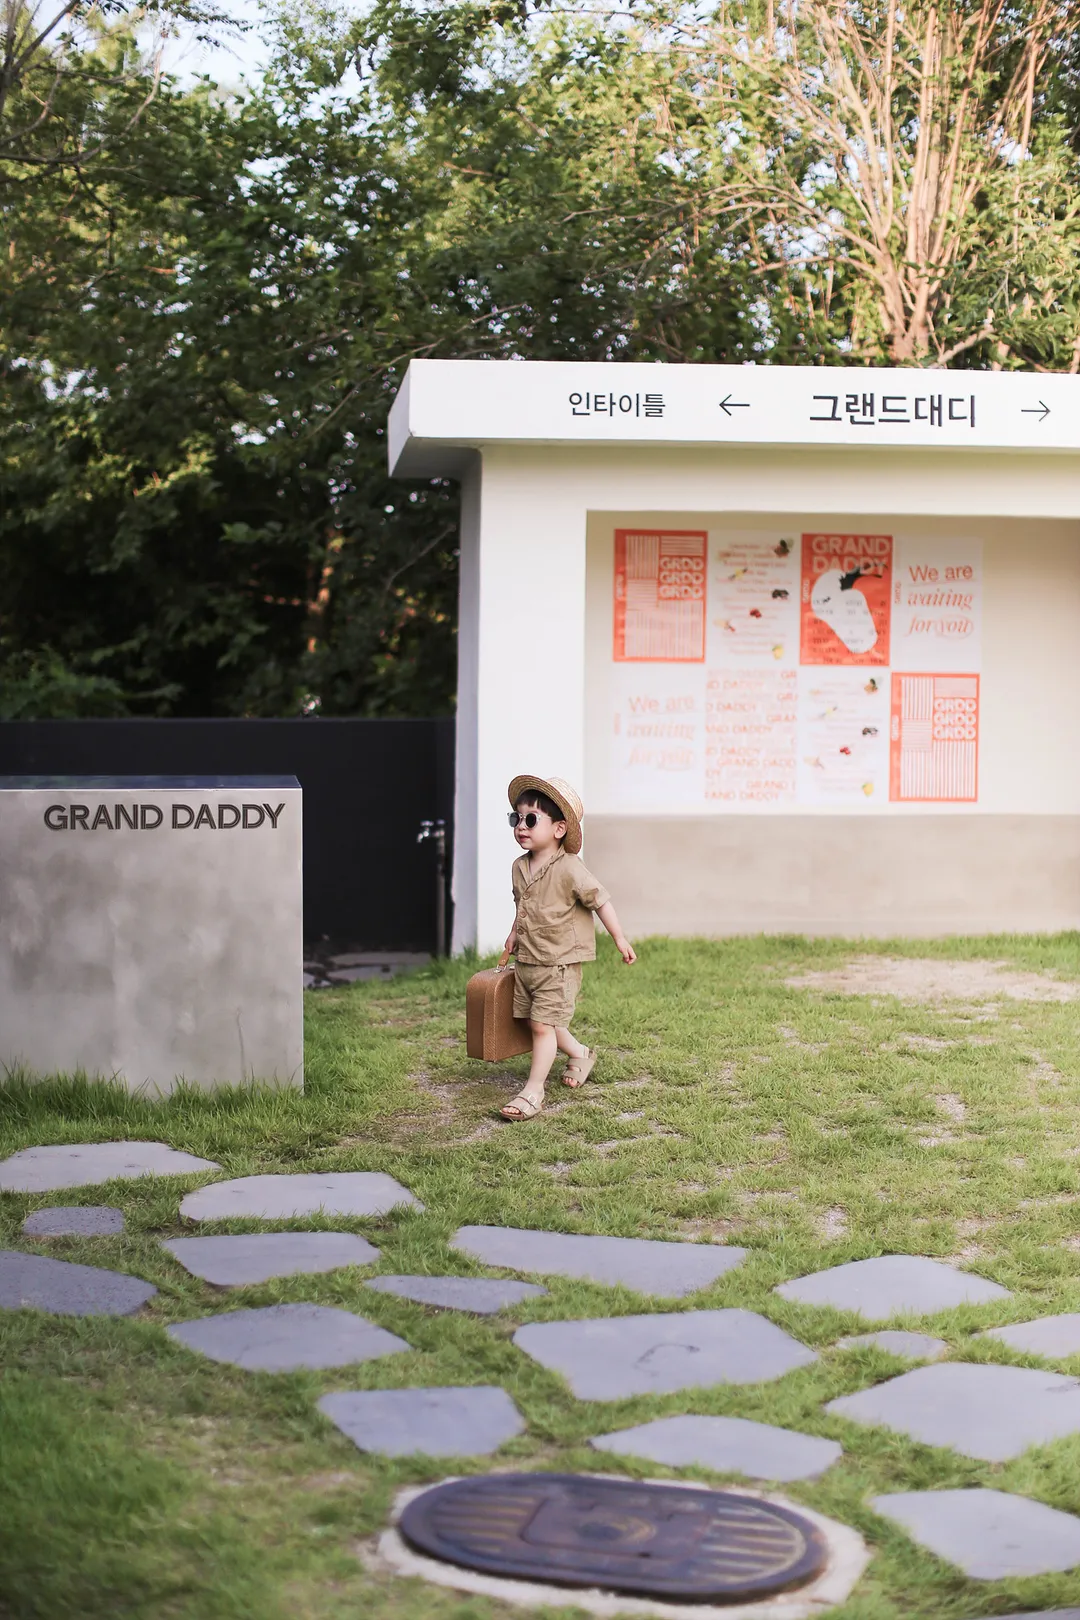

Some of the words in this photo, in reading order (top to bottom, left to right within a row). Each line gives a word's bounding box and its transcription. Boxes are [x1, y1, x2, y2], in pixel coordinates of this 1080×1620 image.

[569, 392, 666, 418] 인타이틀
[810, 393, 976, 428] 그랜드대디
[812, 536, 890, 555] GRAND
[659, 557, 704, 571] GRDD
[812, 556, 889, 575] DADDY
[659, 571, 704, 584] GRDD
[908, 565, 939, 583] We
[945, 565, 973, 581] are
[659, 585, 704, 598] GRDD
[907, 588, 974, 611] waiting
[904, 614, 935, 637] for
[628, 697, 660, 713] We
[665, 696, 695, 713] are
[44, 804, 164, 831] GRAND
[171, 803, 286, 830] DADDY
